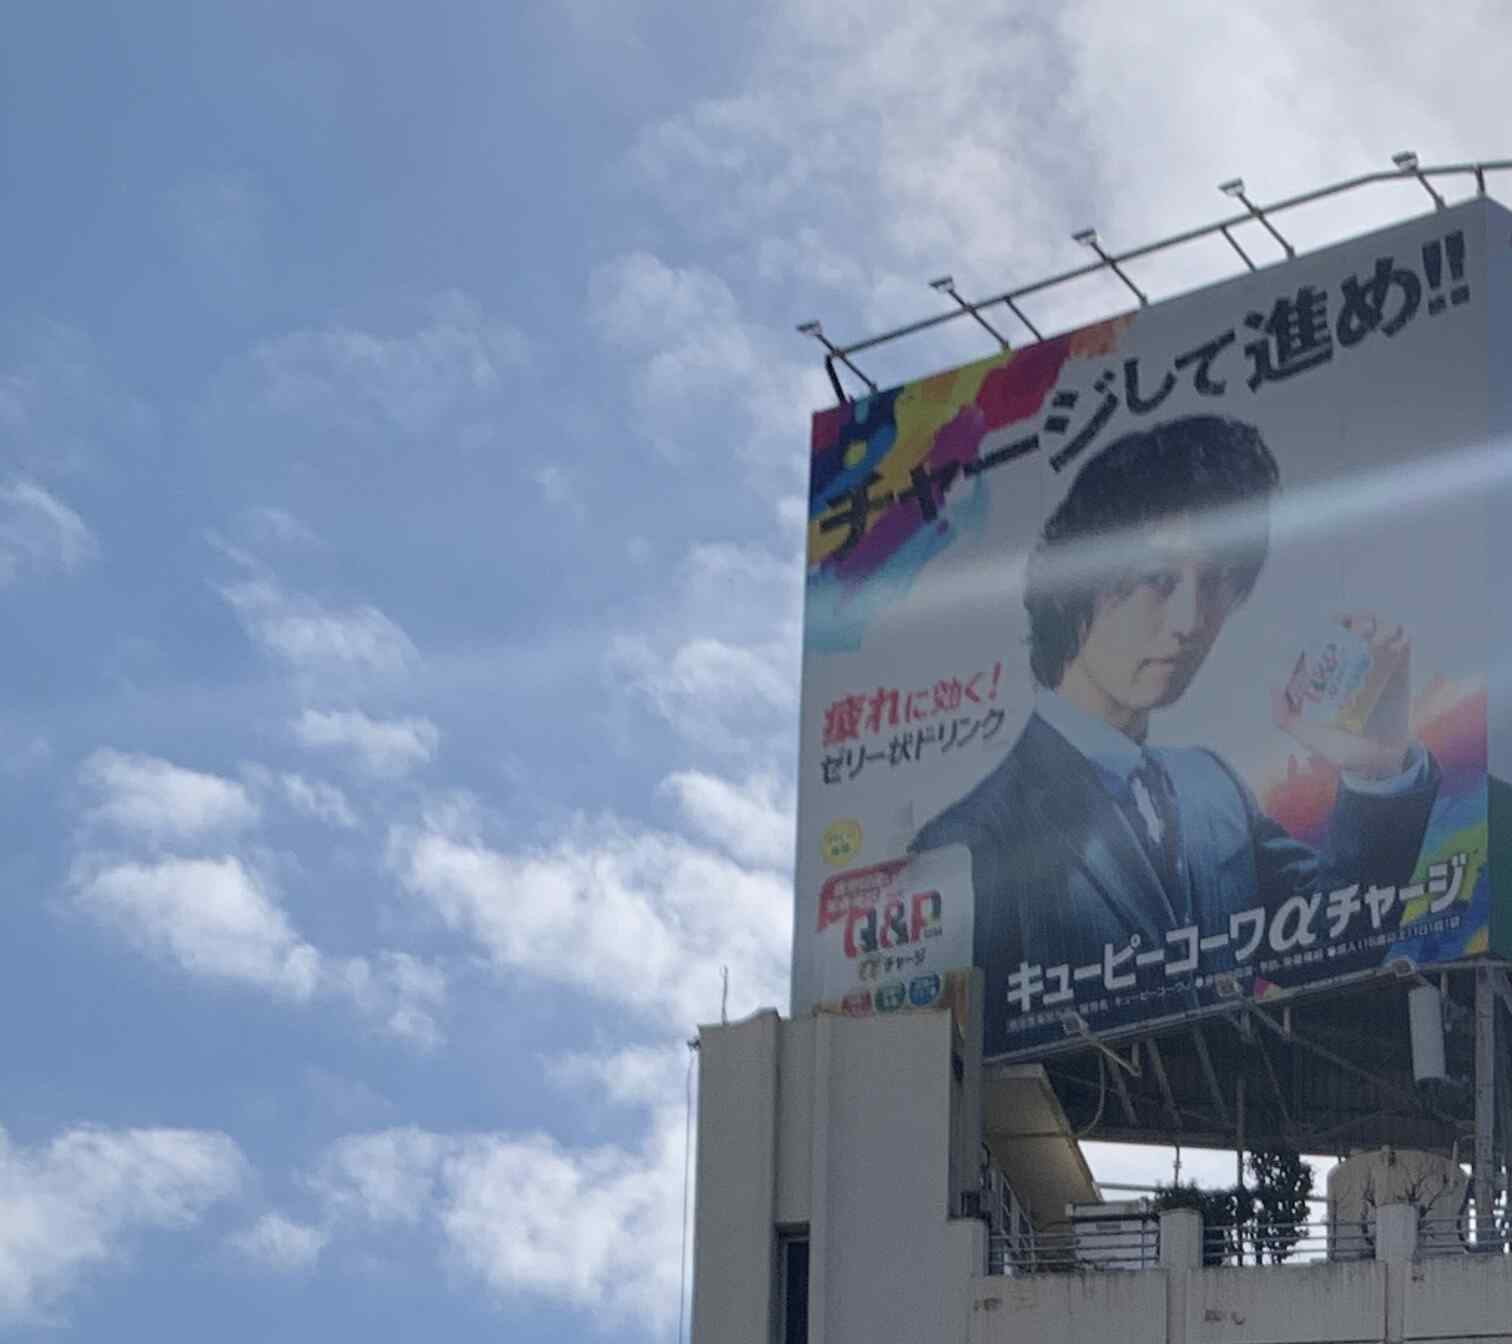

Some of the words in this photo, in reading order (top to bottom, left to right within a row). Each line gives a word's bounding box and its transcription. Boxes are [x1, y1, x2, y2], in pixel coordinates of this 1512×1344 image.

[818, 231, 1471, 556] チャージして進め!!
[820, 707, 1006, 785] ゼリー状ドリンク
[822, 663, 1001, 746] 疲れに効く!
[1007, 853, 1467, 1011] キューピーコーワαチャージ
